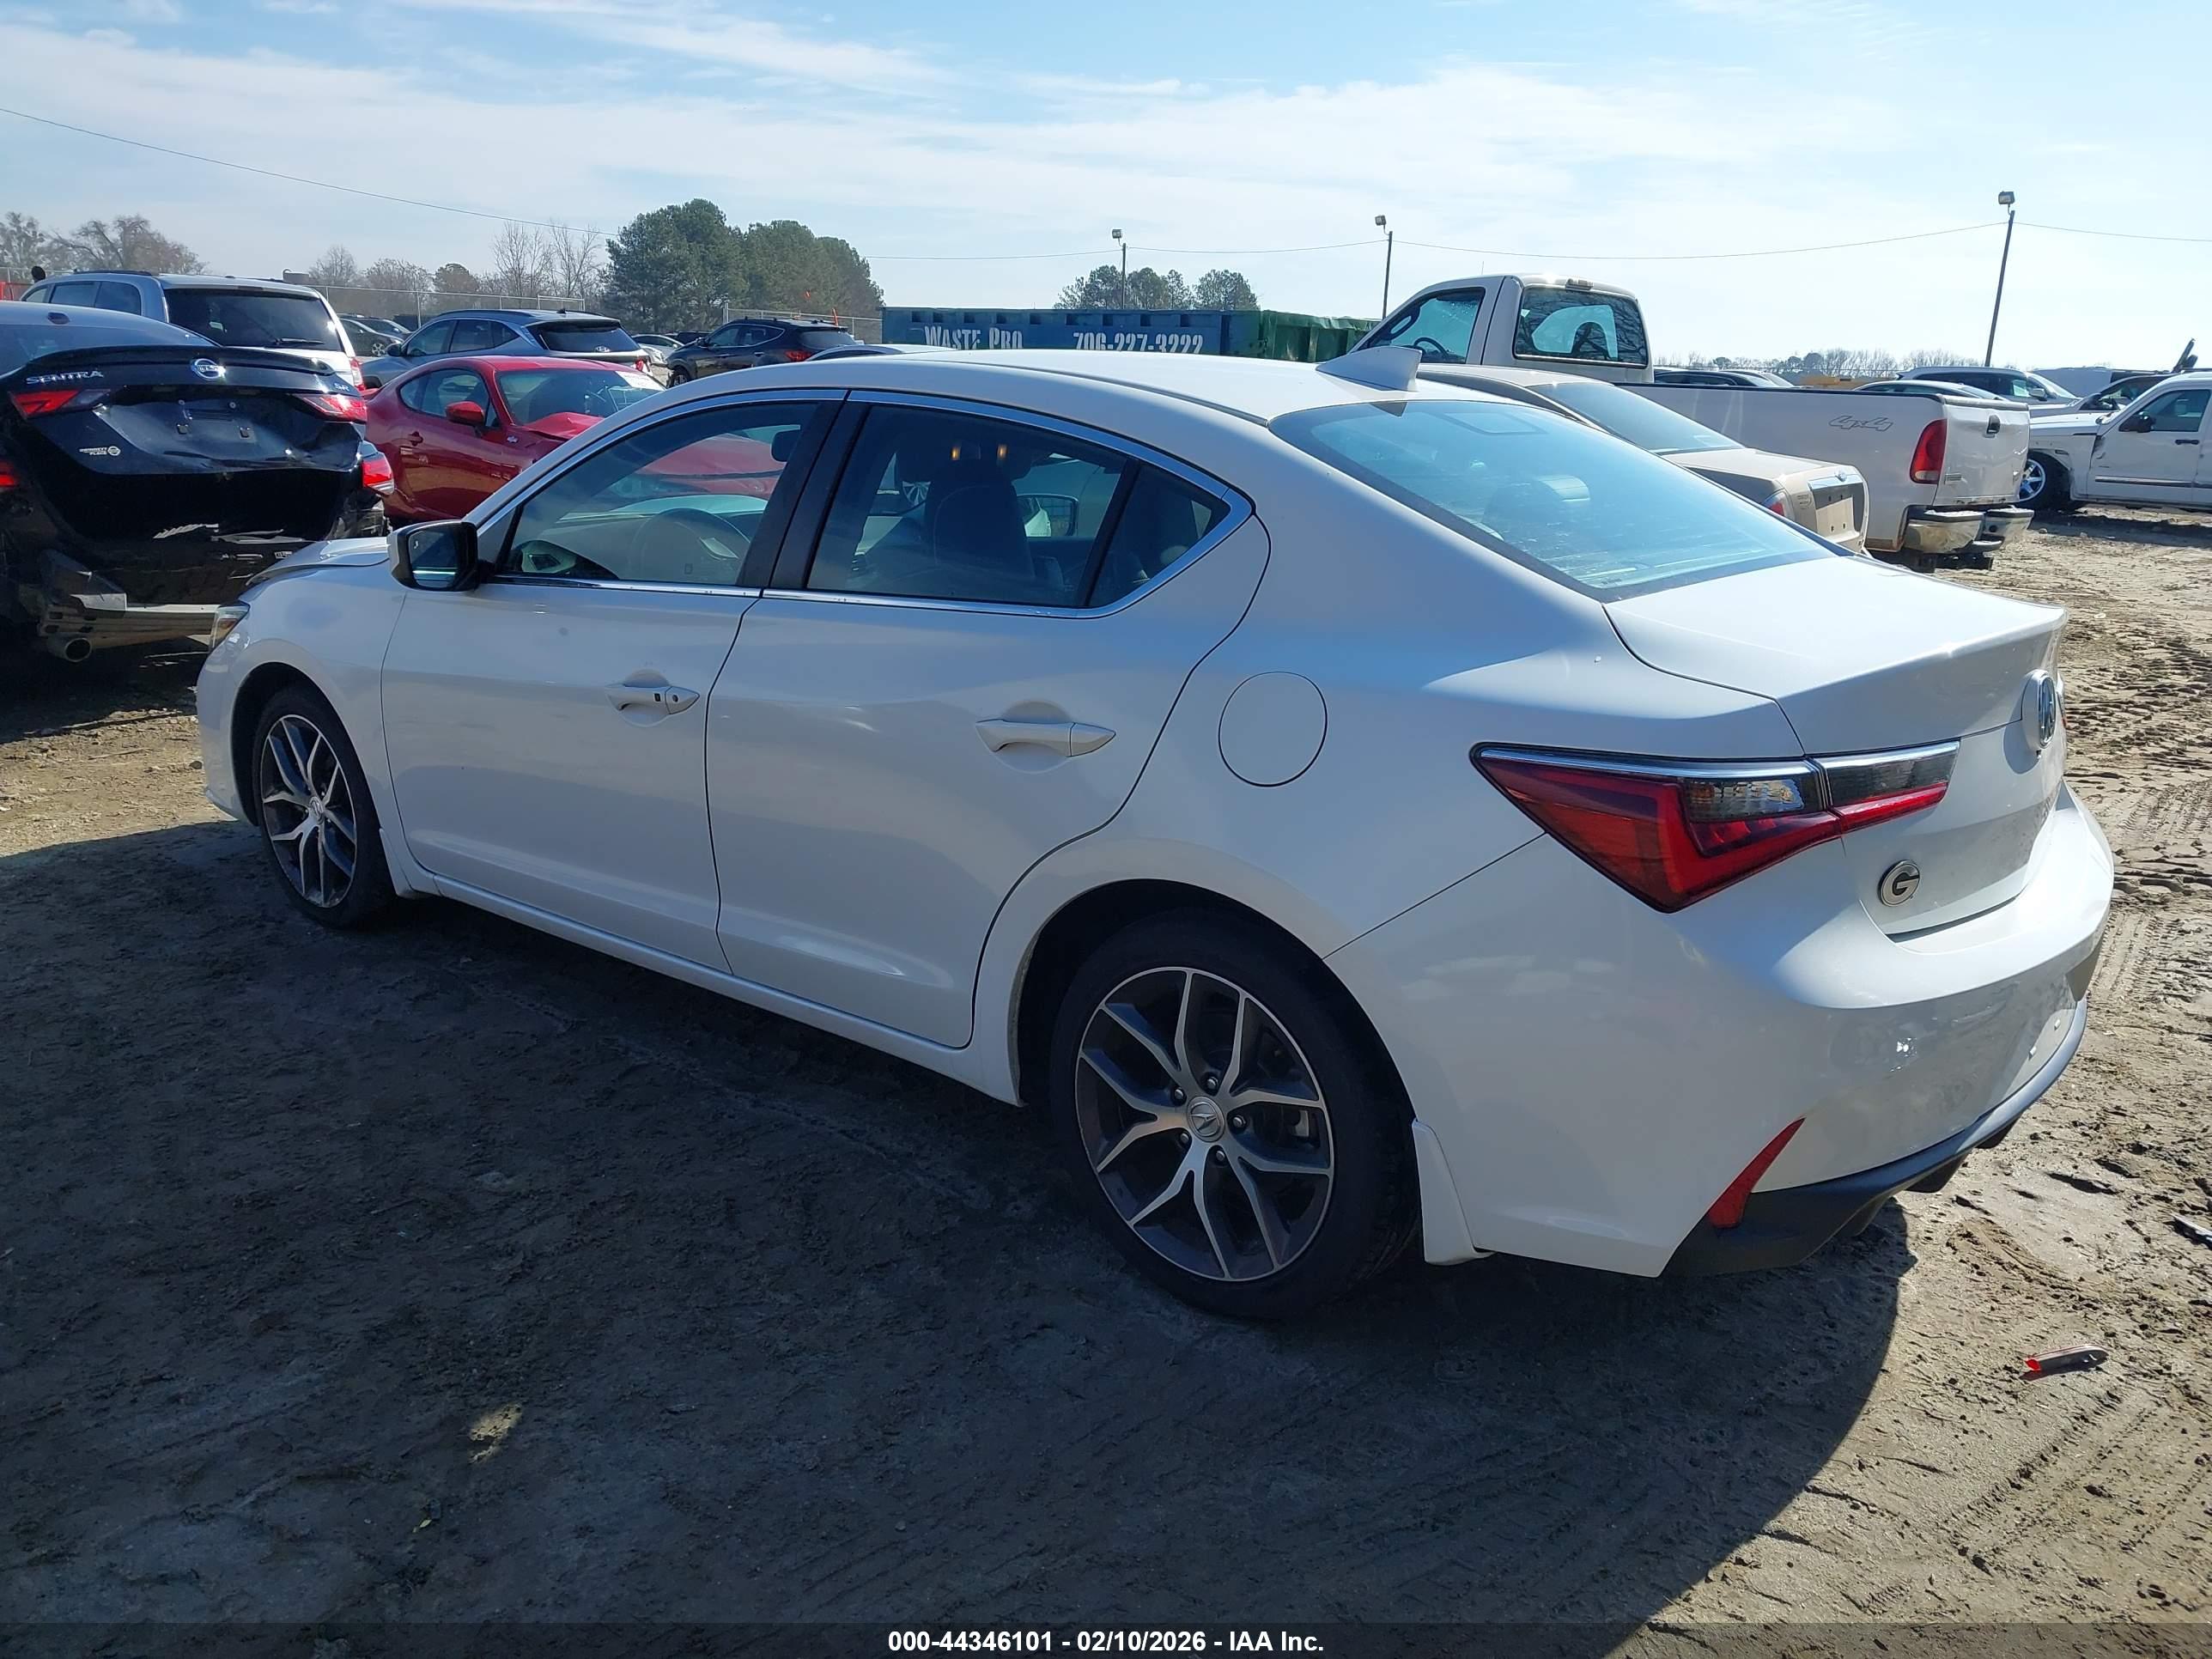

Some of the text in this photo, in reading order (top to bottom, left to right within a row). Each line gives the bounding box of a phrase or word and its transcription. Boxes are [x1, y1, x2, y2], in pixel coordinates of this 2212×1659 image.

[1073, 332, 1203, 354] 706-227-3222
[26, 370, 104, 385] SENTRA
[1881, 863, 1920, 905] G
